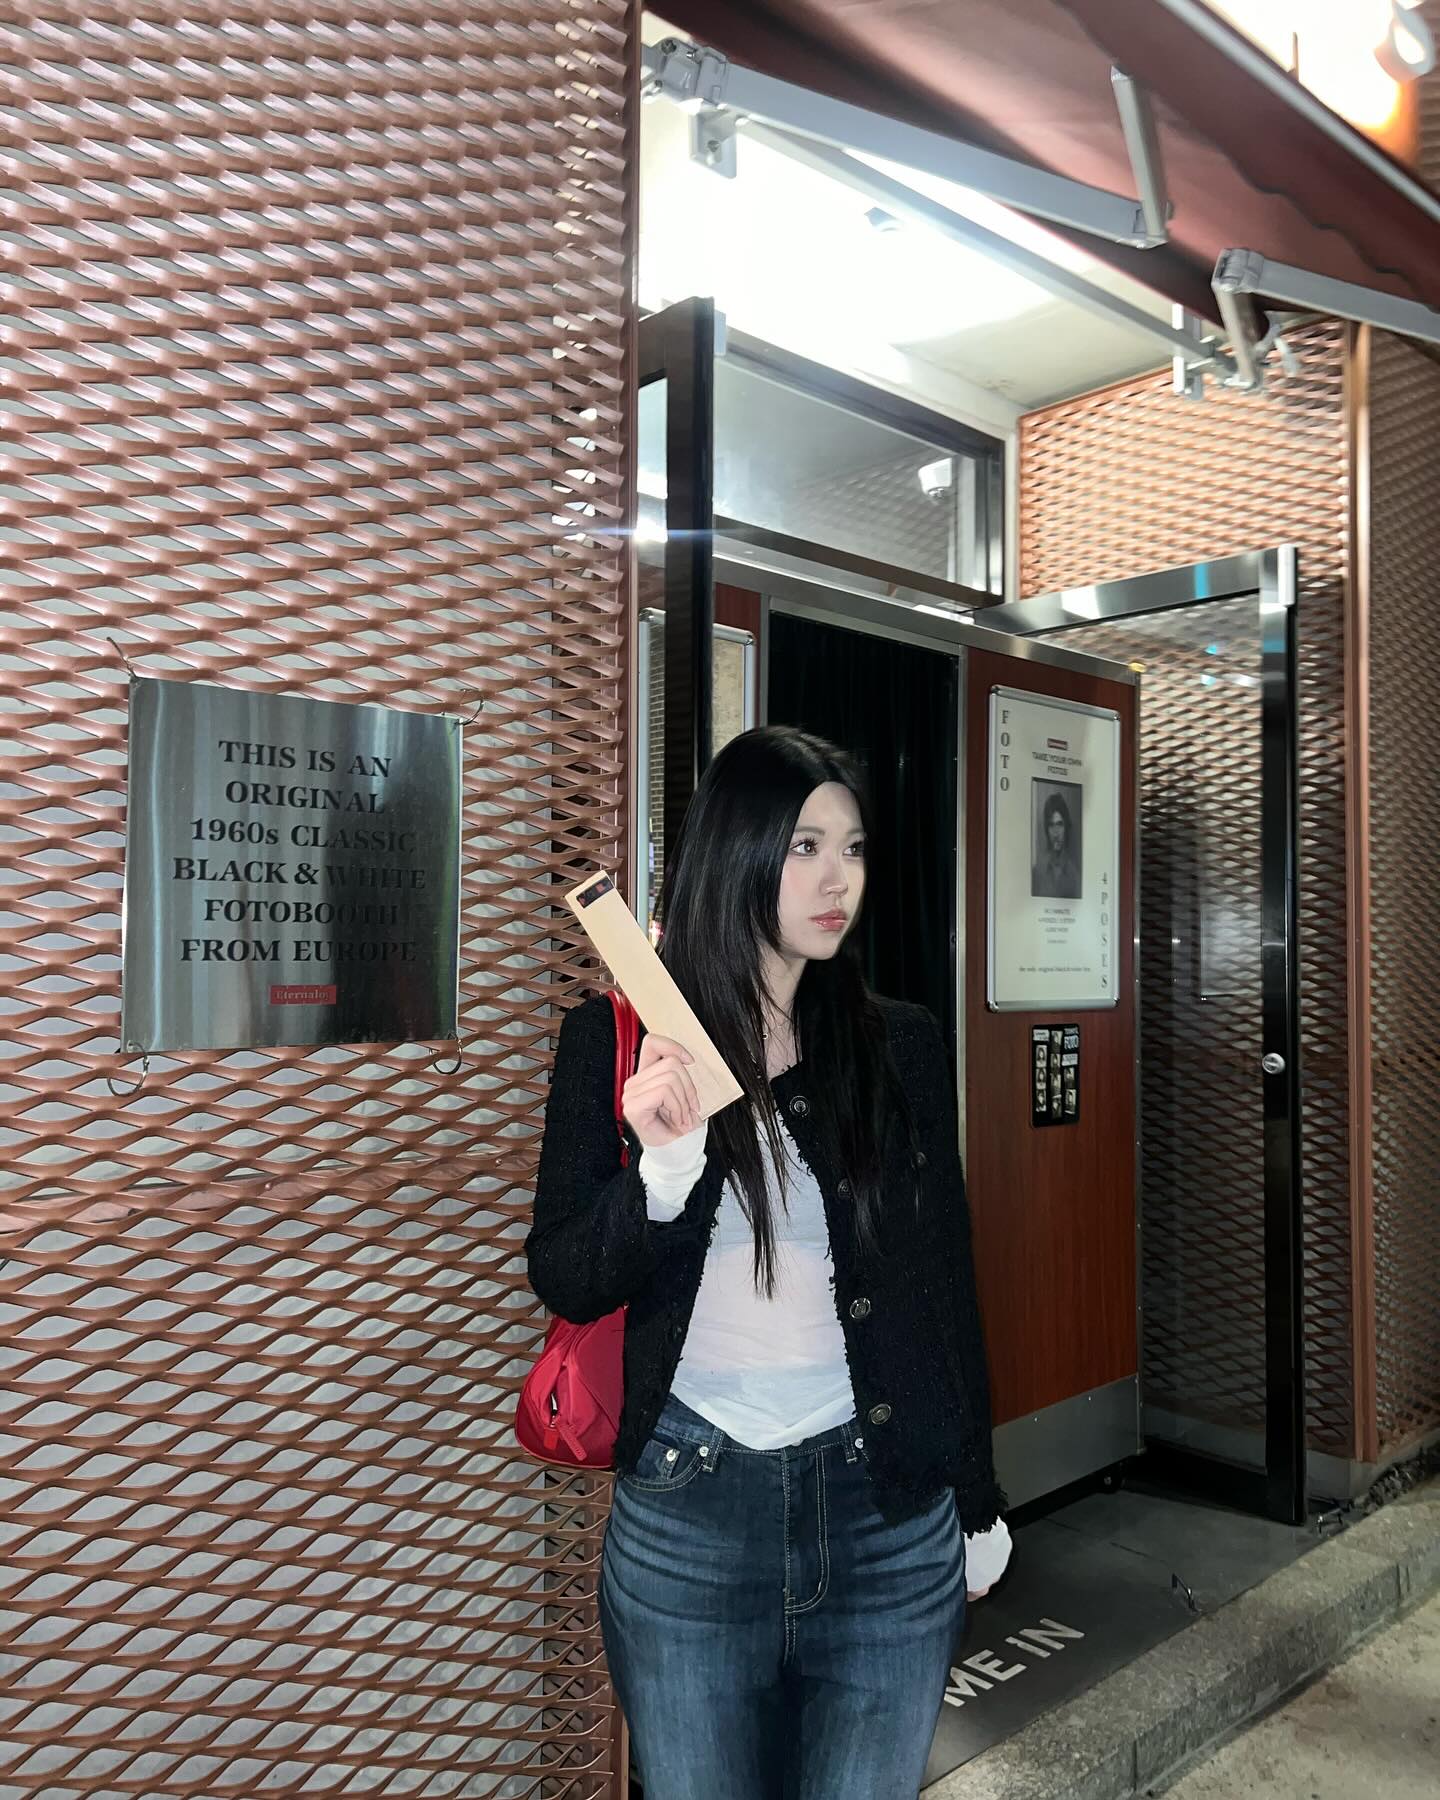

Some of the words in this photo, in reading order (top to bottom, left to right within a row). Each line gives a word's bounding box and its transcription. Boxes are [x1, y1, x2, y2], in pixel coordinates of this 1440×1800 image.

[218, 740, 296, 770] THIS
[307, 749, 336, 773] IS
[347, 754, 393, 779] AN
[1000, 710, 1010, 791] FOTO
[225, 780, 385, 814] ORIGINAL
[189, 817, 279, 846] 1960s
[172, 857, 288, 884] BLACK
[293, 862, 319, 885] &
[326, 866, 426, 889] WHITE
[204, 899, 398, 925] FOTOBOOTH
[180, 939, 280, 963] FROM
[292, 940, 417, 964] EUROPE
[1101, 891, 1109, 988] POSES
[1004, 1618, 1085, 1658] IN
